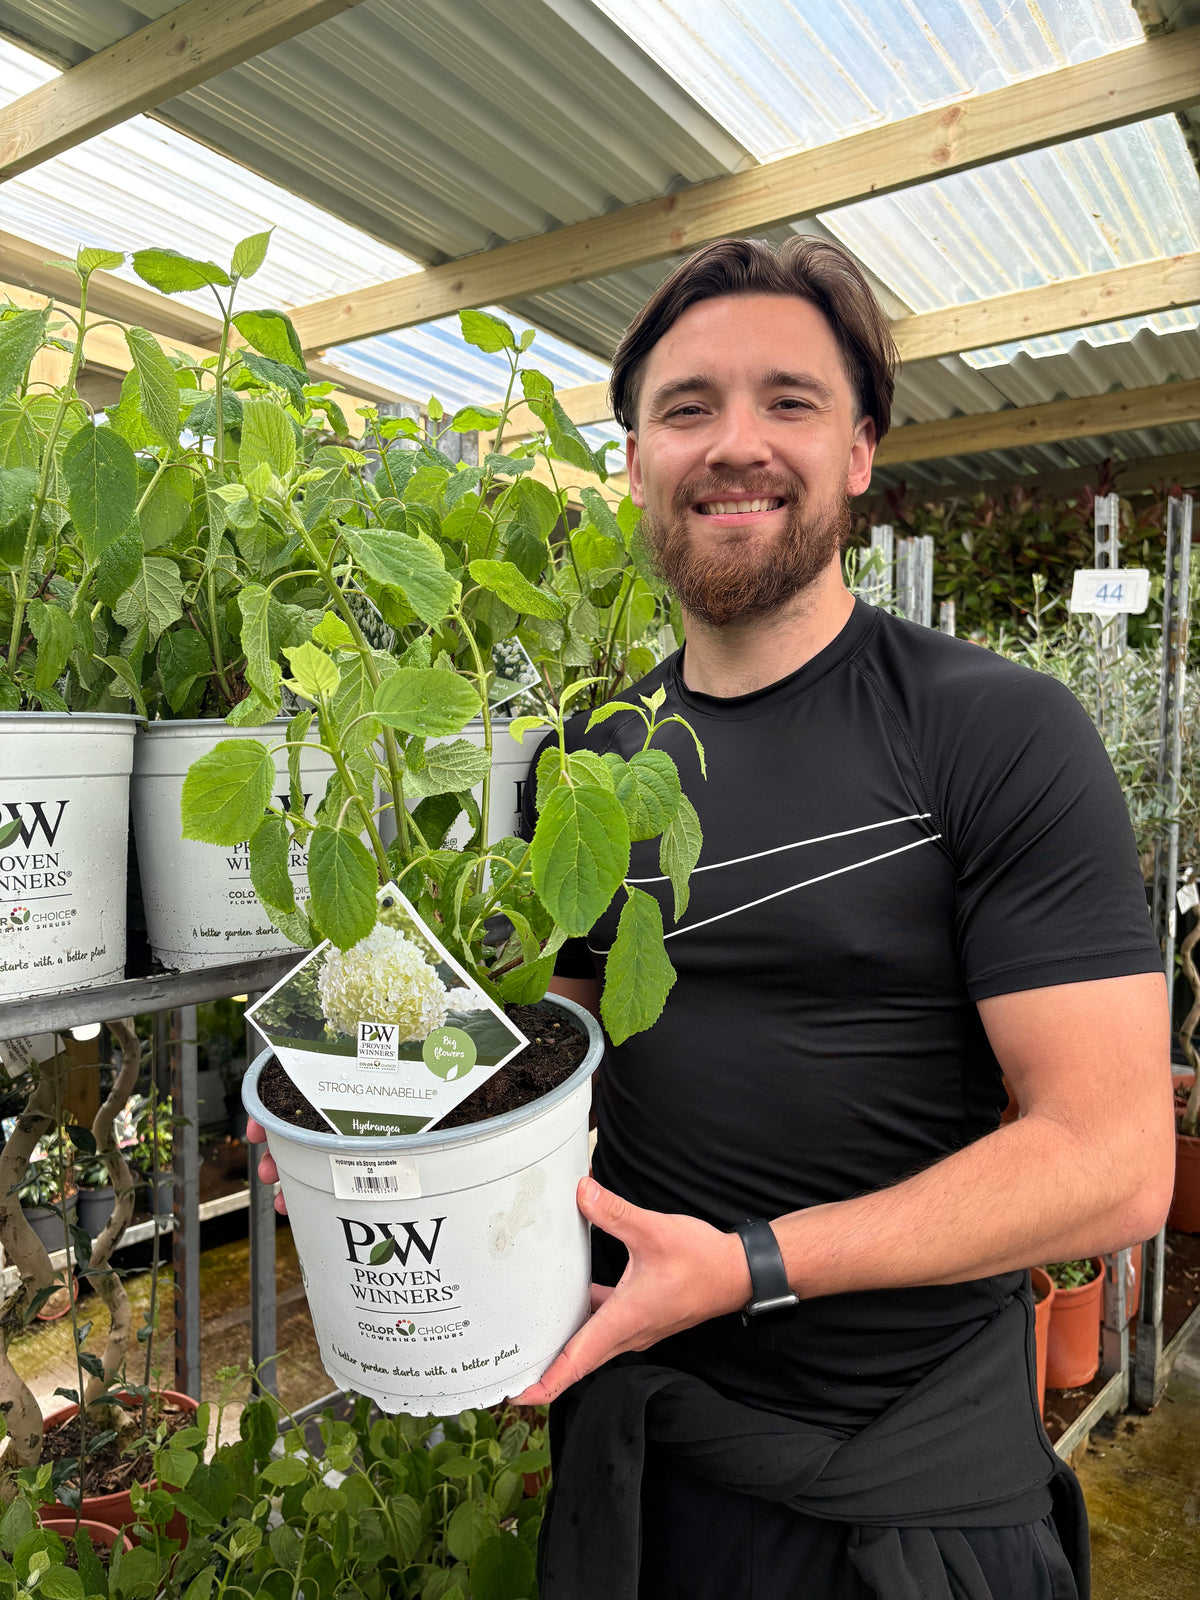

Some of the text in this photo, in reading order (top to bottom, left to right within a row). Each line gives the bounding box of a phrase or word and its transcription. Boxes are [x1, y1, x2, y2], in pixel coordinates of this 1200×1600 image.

[1096, 583, 1123, 602] 44
[0, 800, 70, 849] W
[229, 890, 256, 899] COLO
[32, 909, 77, 923] CHOICE®
[192, 928, 198, 938] A
[200, 926, 221, 937] better
[224, 928, 253, 941] garden
[34, 957, 54, 968] with
[57, 955, 63, 964] a
[66, 949, 88, 963] better
[90, 944, 107, 957] plant
[361, 1023, 395, 1043] PW
[362, 1042, 391, 1050] PROVEN
[443, 1036, 457, 1049] Big
[434, 1047, 465, 1060] flowers
[318, 1081, 438, 1100] STRONG ANNABELLE®
[352, 1118, 400, 1136] Hydrangea
[336, 1216, 447, 1266] PW
[354, 1268, 442, 1287] PROVEN
[350, 1284, 460, 1305] WINNERS®
[358, 1319, 470, 1336] COLOR CHOICE®
[360, 1331, 463, 1343] FLOWERING SHRUBS
[338, 1348, 358, 1365] better
[360, 1361, 389, 1373] garden
[393, 1366, 420, 1377] starts
[424, 1365, 447, 1376] with
[462, 1358, 490, 1371] better
[494, 1343, 521, 1366] plant
